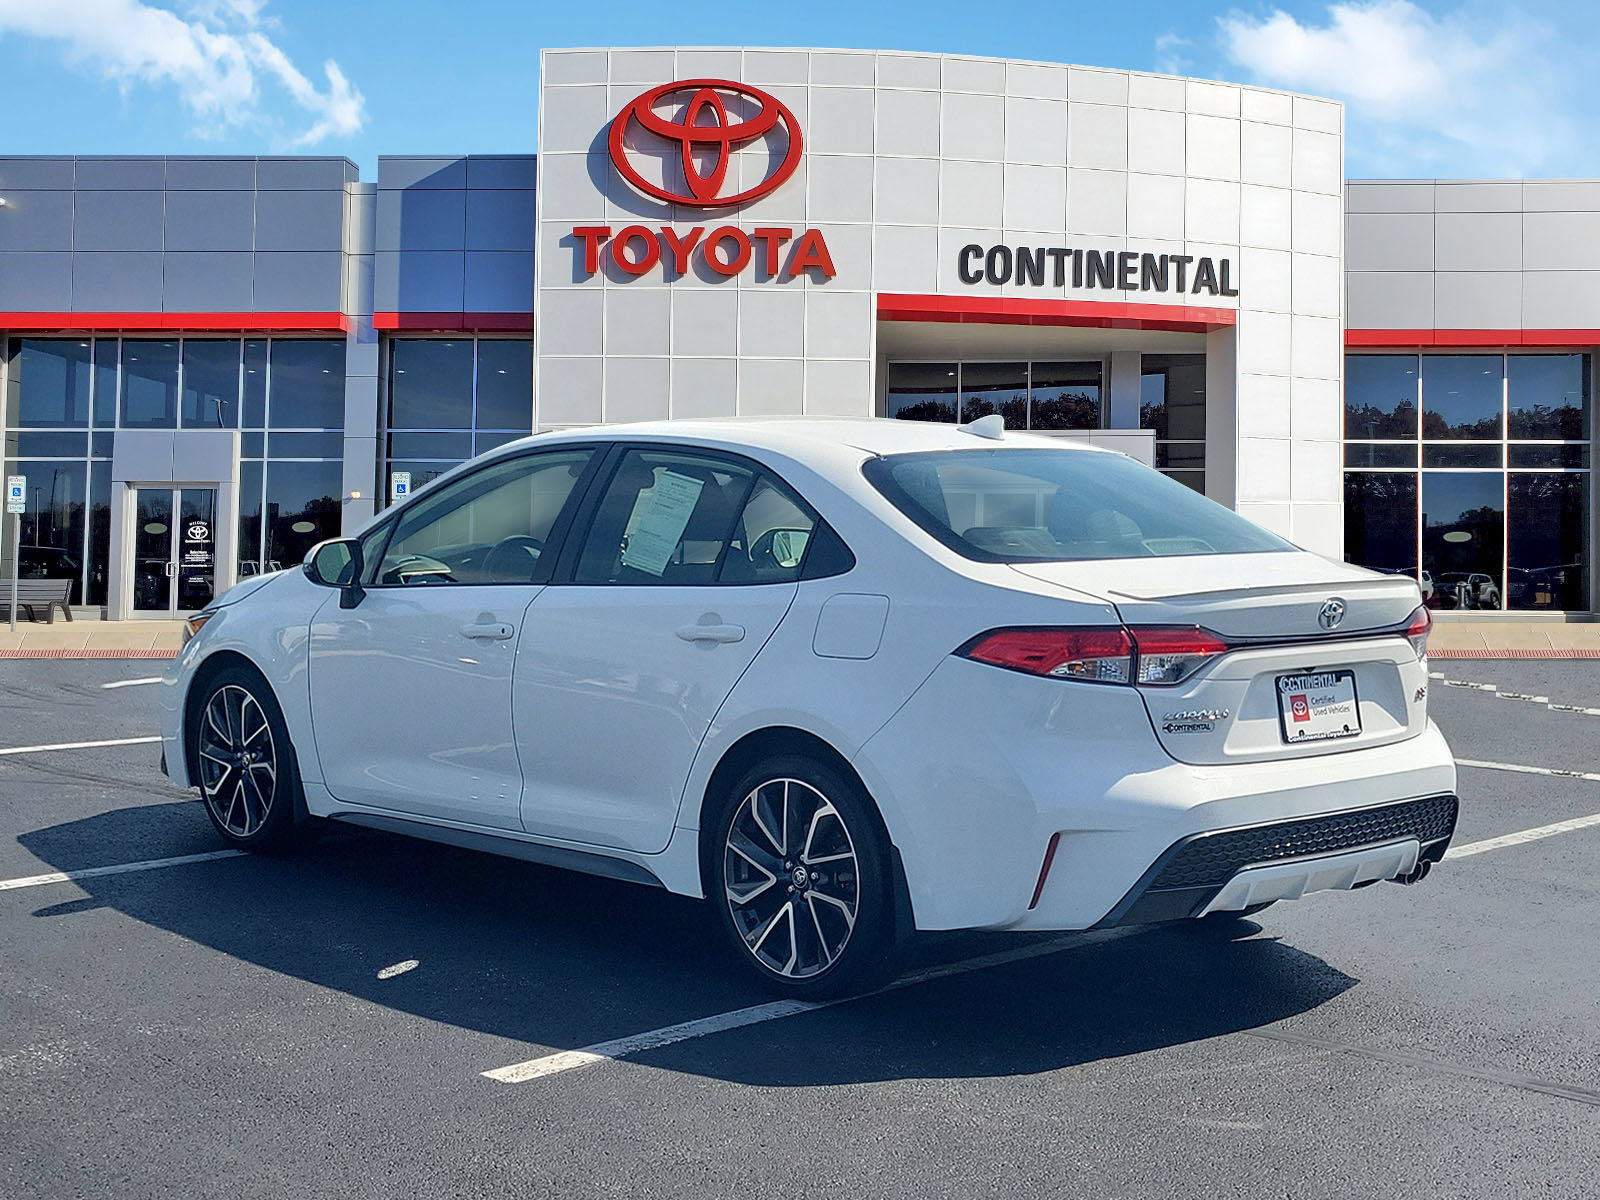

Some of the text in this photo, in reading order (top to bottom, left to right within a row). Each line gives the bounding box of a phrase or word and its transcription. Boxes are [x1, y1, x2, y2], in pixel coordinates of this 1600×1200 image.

[572, 225, 837, 277] TOYOTA
[958, 244, 1239, 297] CONTINENTAL
[1279, 673, 1337, 693] CONTINENTAL
[1311, 695, 1336, 706] Certified
[1313, 704, 1351, 716] Used Vehicles
